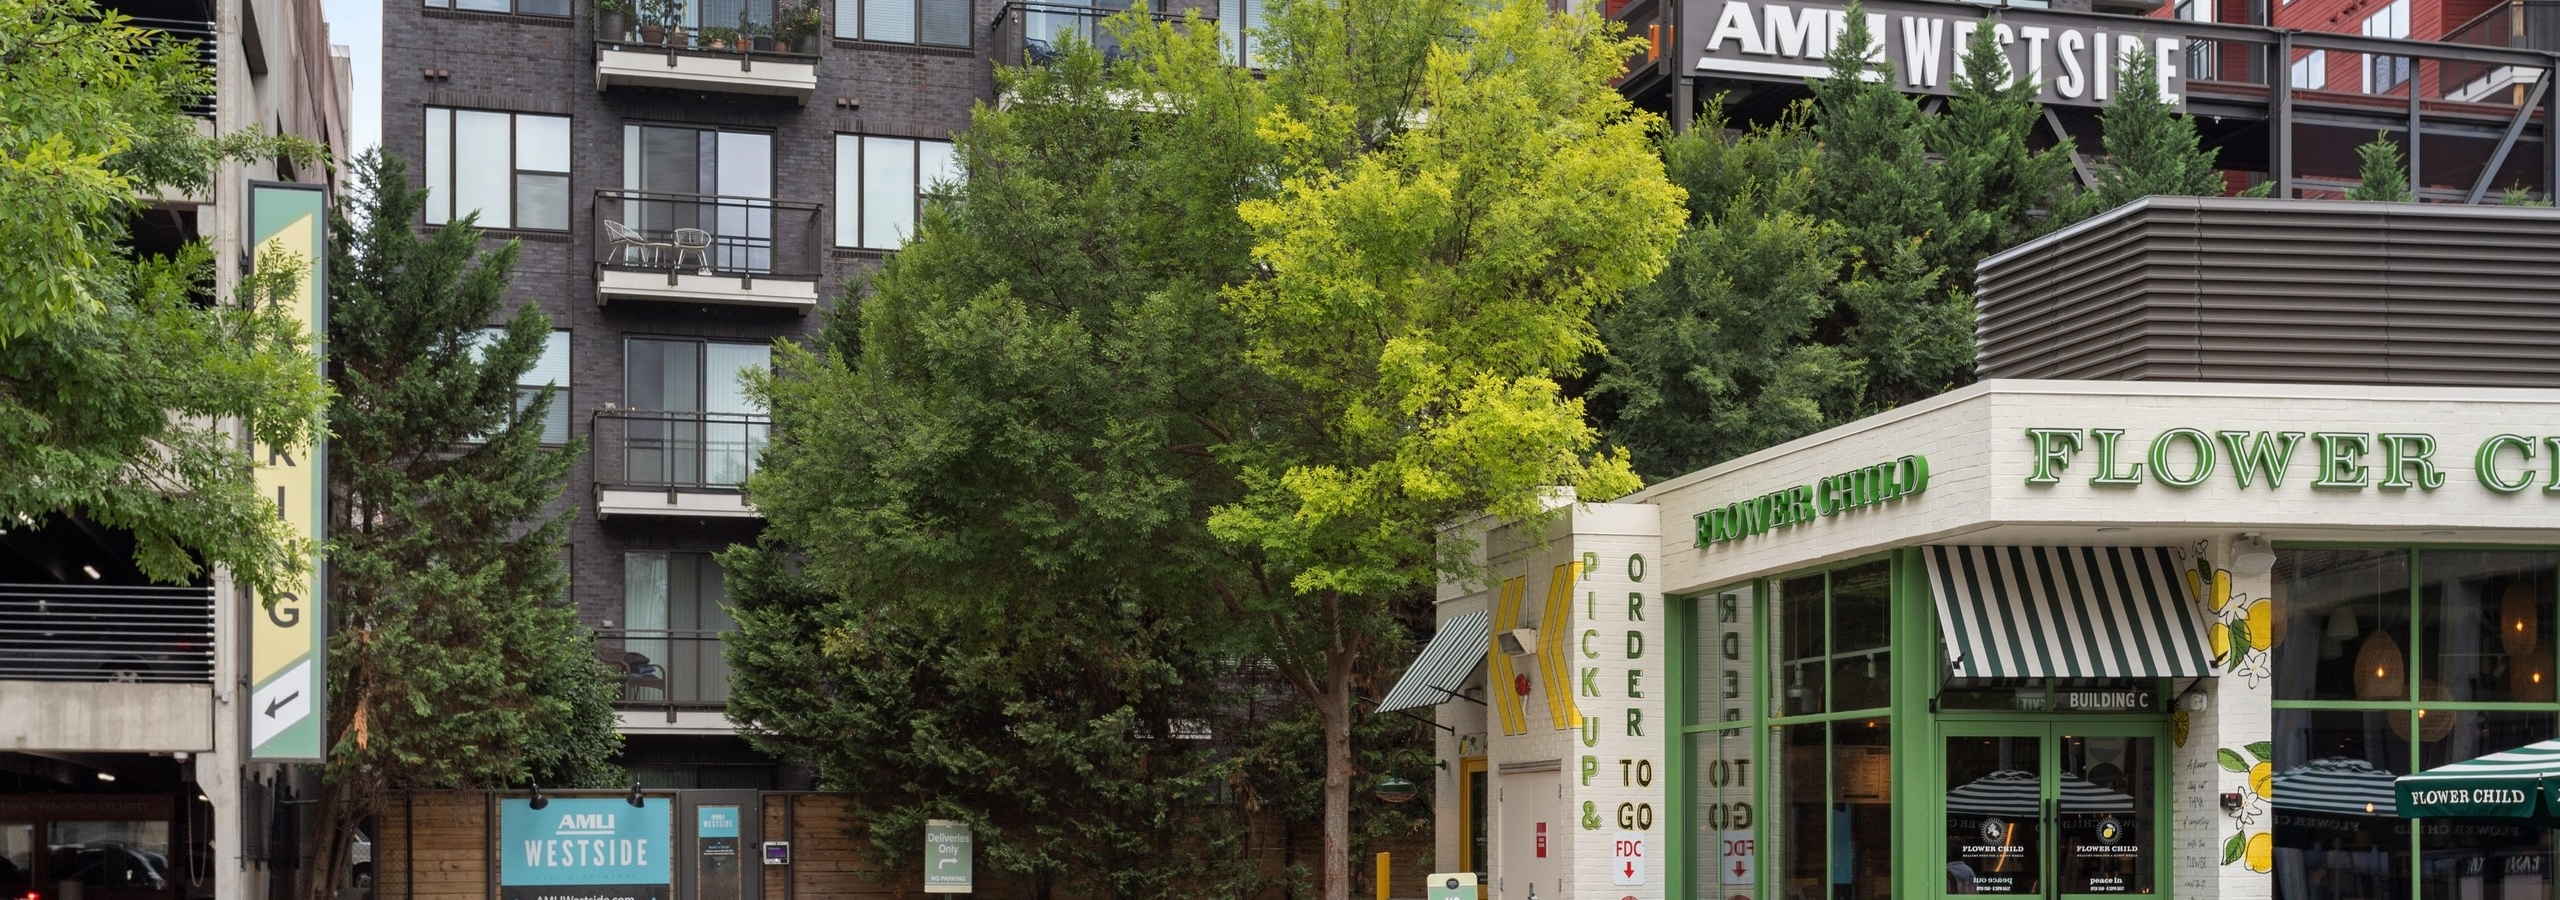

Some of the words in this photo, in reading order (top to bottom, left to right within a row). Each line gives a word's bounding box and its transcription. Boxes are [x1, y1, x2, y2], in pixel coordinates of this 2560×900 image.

[2024, 427, 2446, 490] FLOWER
[1693, 485, 1815, 548] FLOWER
[1816, 454, 1929, 517] CHILD
[1627, 553, 1647, 736] ORDER
[1582, 552, 1601, 786] PICKUP
[2070, 692, 2135, 708] BUILDING
[2139, 692, 2149, 708] C
[1619, 759, 1653, 787] TO
[2411, 790, 2469, 806] FLOWER
[2473, 789, 2525, 804] CHILD
[558, 814, 615, 830] AMLI
[1582, 800, 1602, 831] &
[1617, 802, 1653, 831] GO
[928, 833, 970, 843] Deliveries
[938, 844, 959, 855] Only
[1616, 840, 1642, 857] FDC
[524, 839, 648, 867] WESTSIDE
